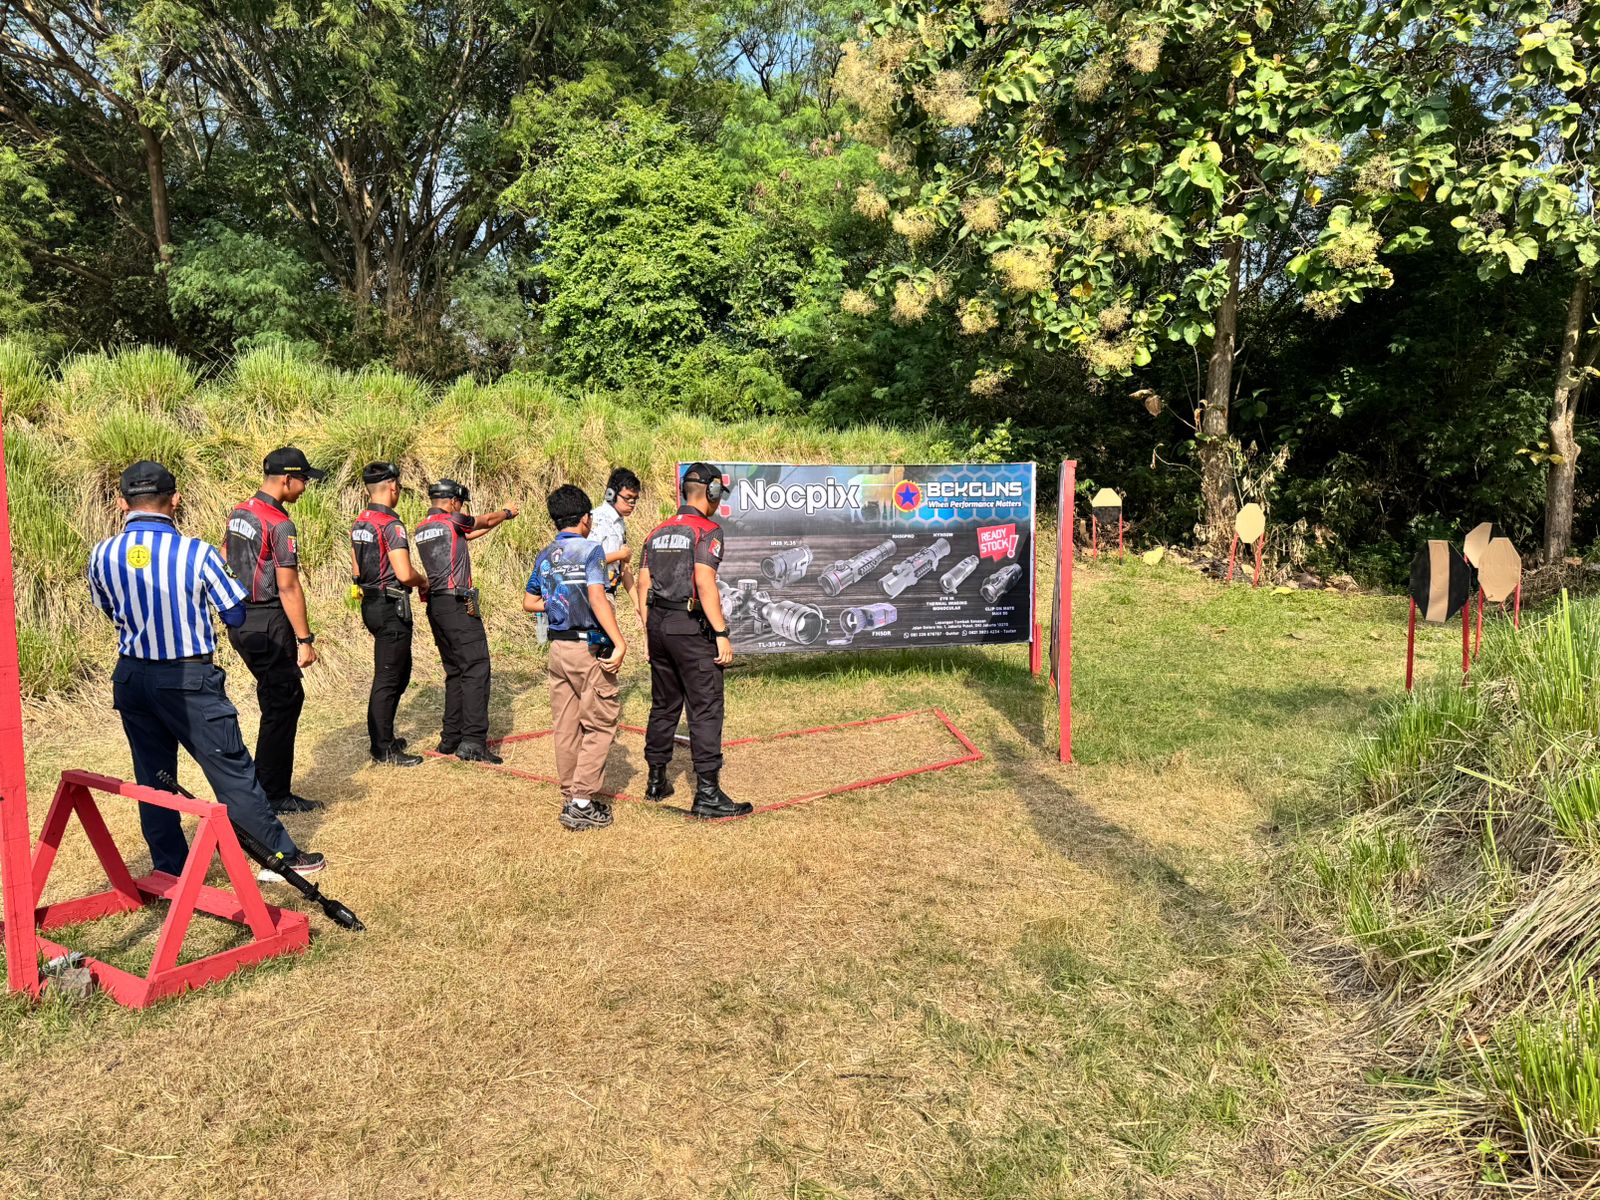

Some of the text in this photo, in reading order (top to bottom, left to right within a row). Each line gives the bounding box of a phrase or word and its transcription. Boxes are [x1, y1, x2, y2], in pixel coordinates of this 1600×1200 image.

[739, 478, 861, 515] Nocpix
[927, 481, 1022, 497] BCKGUNS
[928, 500, 1021, 509] When Performance Matters
[981, 527, 1007, 542] READY
